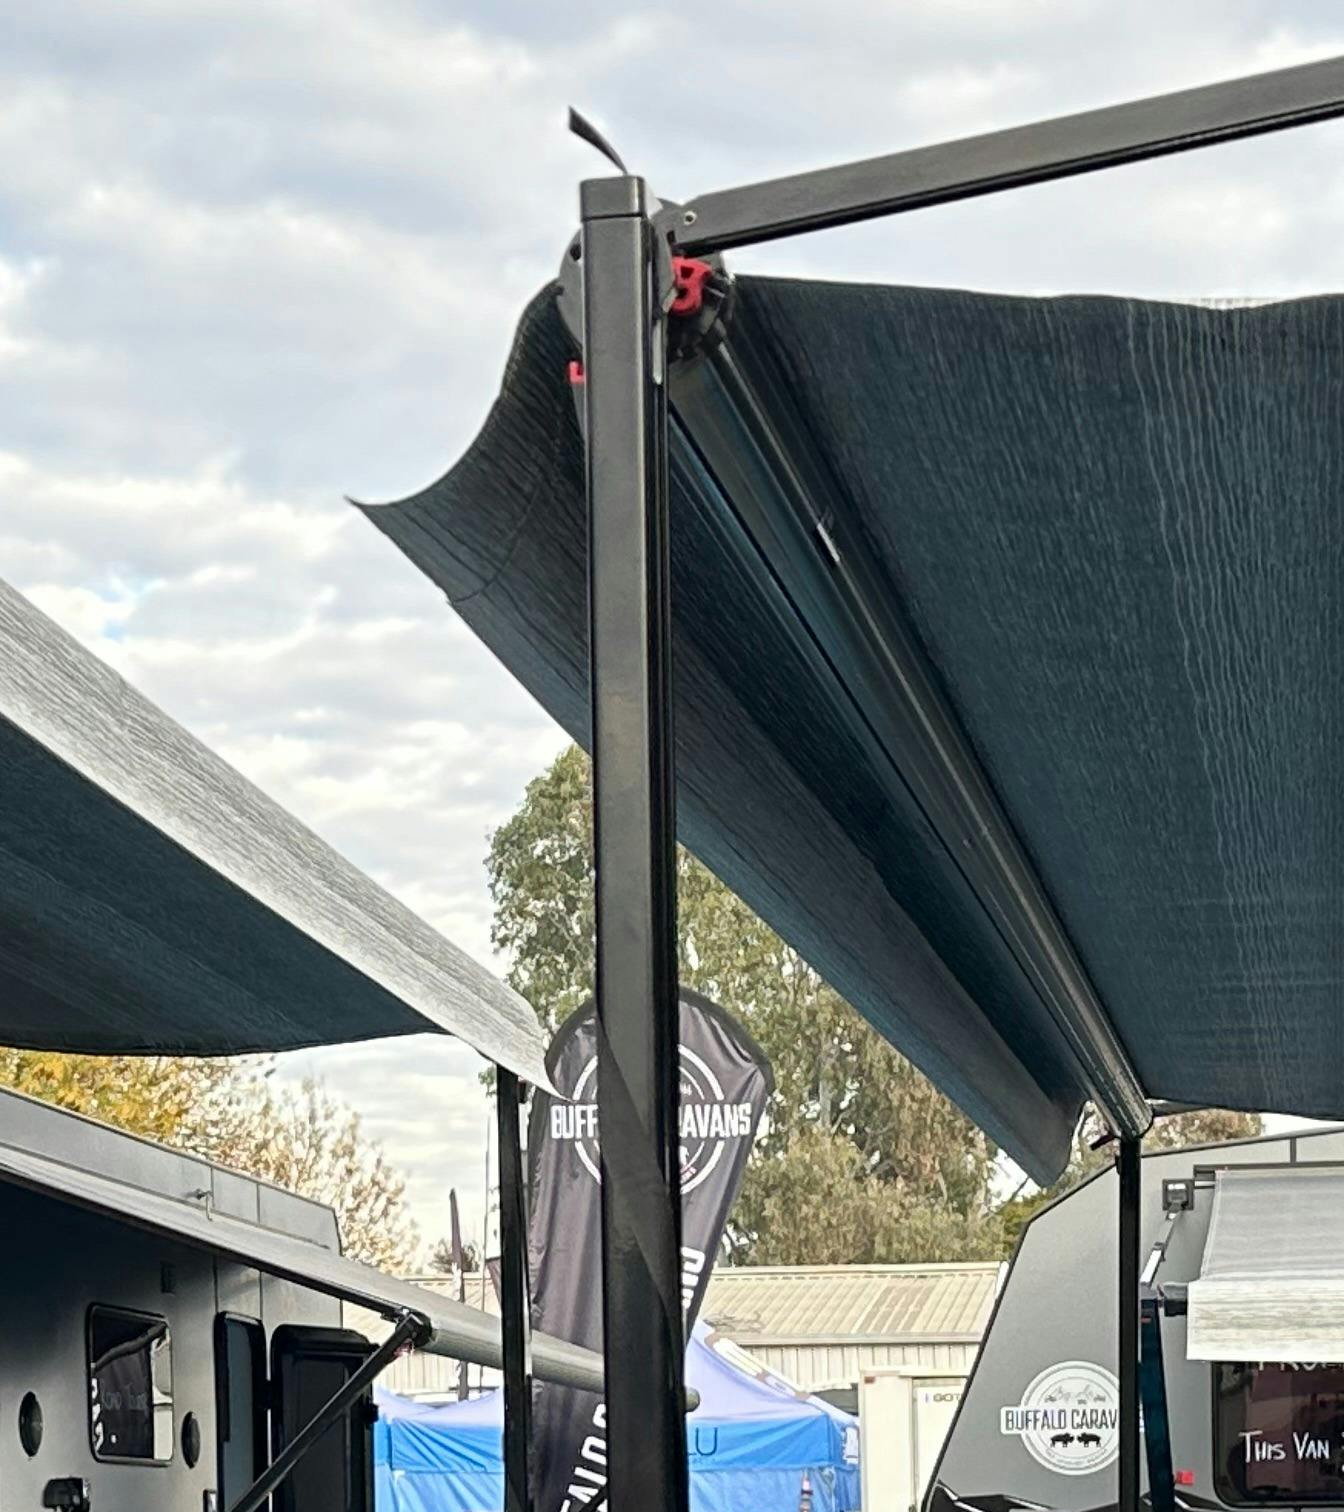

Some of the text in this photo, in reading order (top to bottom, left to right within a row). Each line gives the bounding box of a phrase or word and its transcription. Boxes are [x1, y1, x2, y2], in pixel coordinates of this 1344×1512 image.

[550, 1102, 752, 1138] BUFF AVANS
[1006, 1408, 1117, 1430] BUFFALO CARAV
